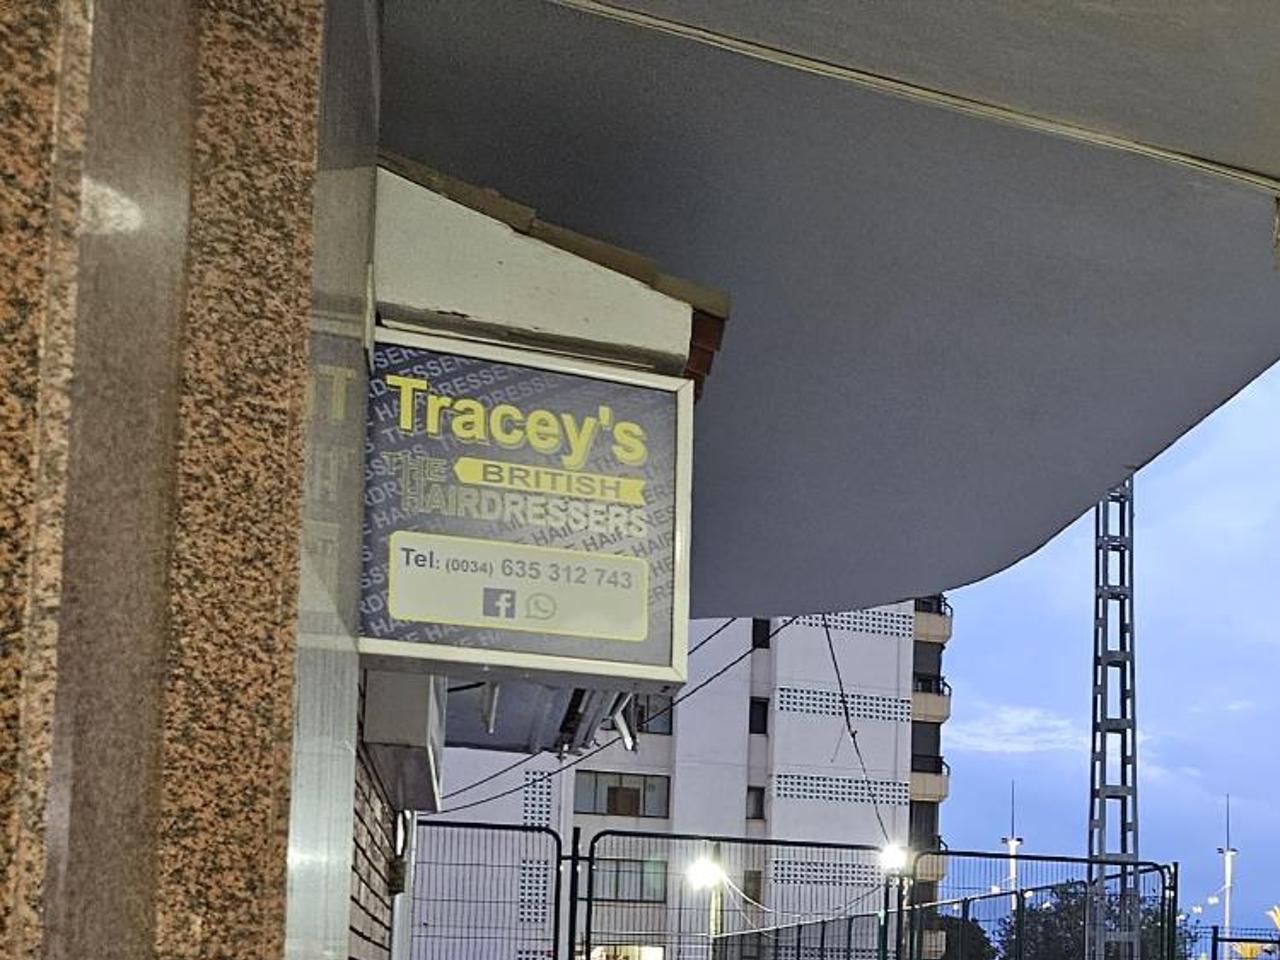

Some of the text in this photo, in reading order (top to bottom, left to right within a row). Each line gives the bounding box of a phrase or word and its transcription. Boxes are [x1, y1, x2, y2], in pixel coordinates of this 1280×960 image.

[386, 375, 649, 468] Tracey's
[481, 464, 621, 499] BRITISH
[401, 479, 648, 538] HAIRDRESSERS
[401, 547, 441, 570] Tel:
[445, 558, 494, 577] (0034)
[501, 558, 542, 581] 635
[549, 563, 588, 586] 312
[594, 568, 632, 590] 743
